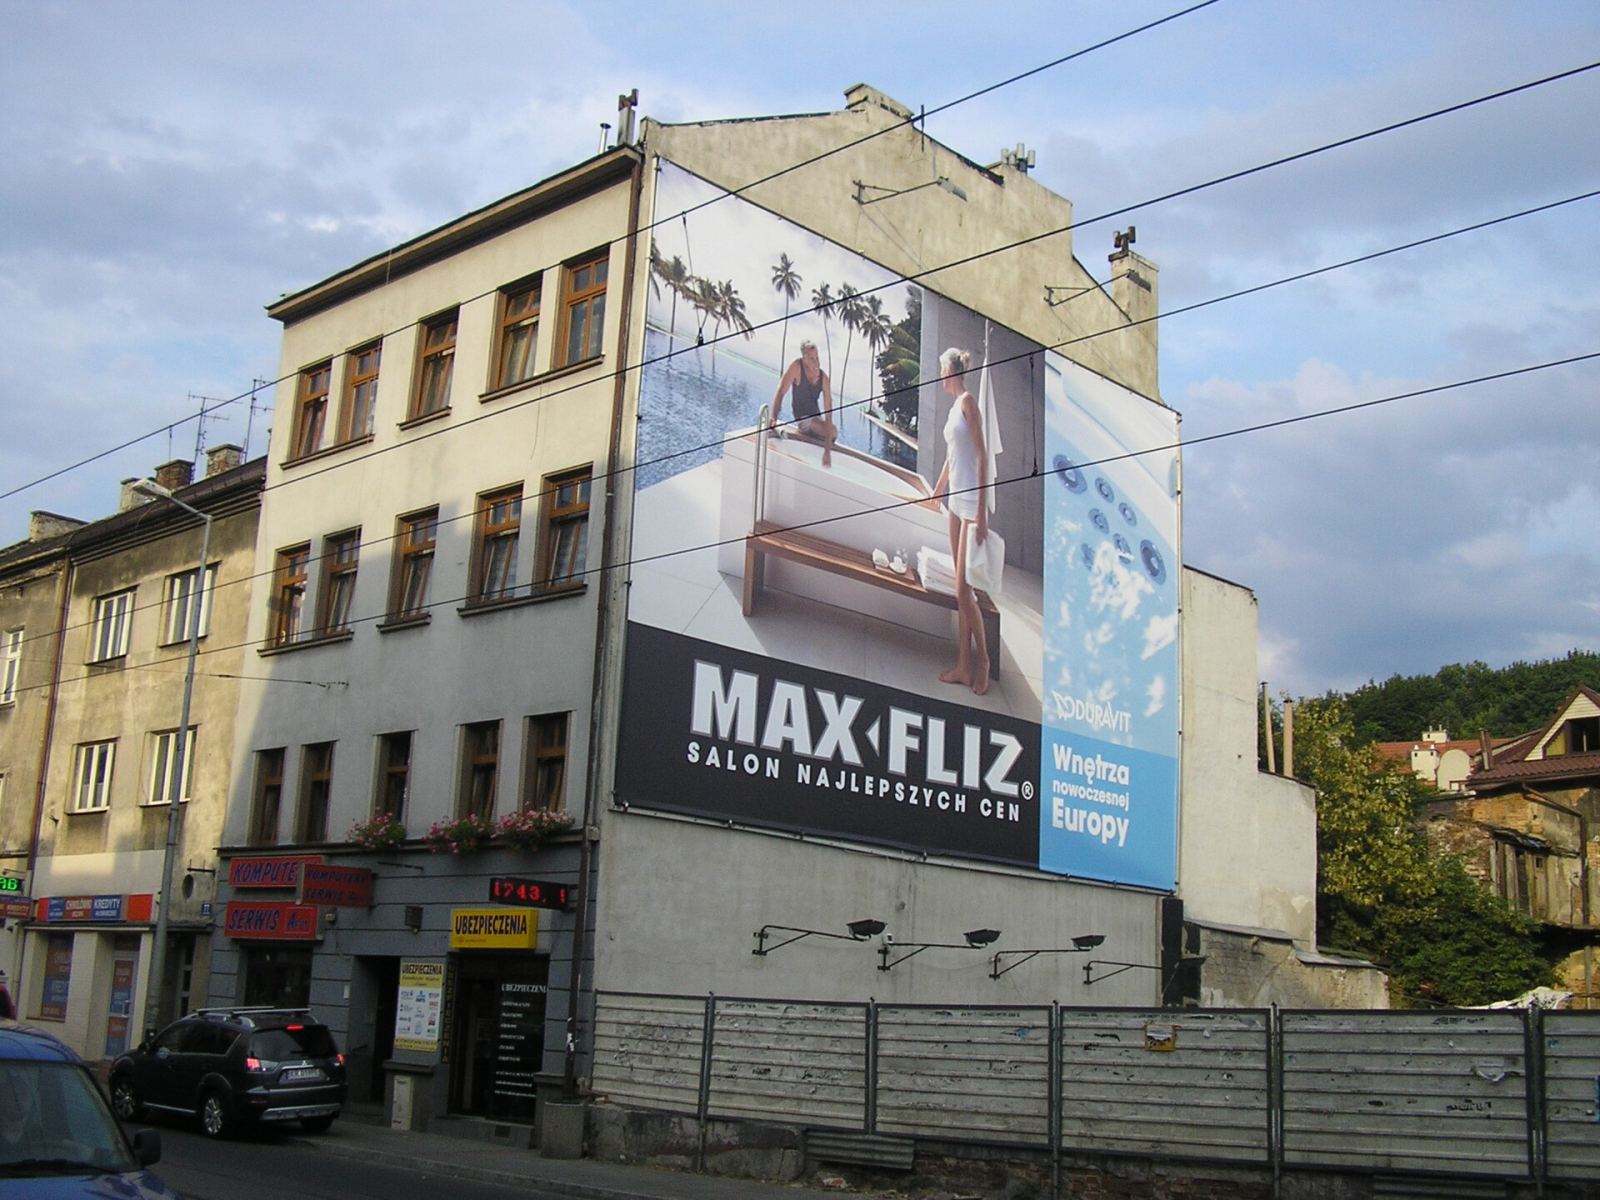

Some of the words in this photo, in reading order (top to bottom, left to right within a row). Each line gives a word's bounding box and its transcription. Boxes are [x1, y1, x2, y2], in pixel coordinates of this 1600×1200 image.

[690, 659, 864, 767] MAX
[888, 706, 1024, 798] FLIZ
[1075, 699, 1132, 732] DURAVIT
[1052, 743, 1130, 785] Wnętrza
[687, 741, 780, 779] SALON
[797, 763, 967, 813] NAJLEPSZYCH
[980, 798, 1020, 822] CEN
[1052, 780, 1130, 811] nowoczesnej
[1052, 797, 1129, 847] Europy
[233, 862, 297, 882] KOMPUTE
[229, 909, 280, 931] SERWIS
[455, 914, 528, 935] UBEZPIECZENIA
